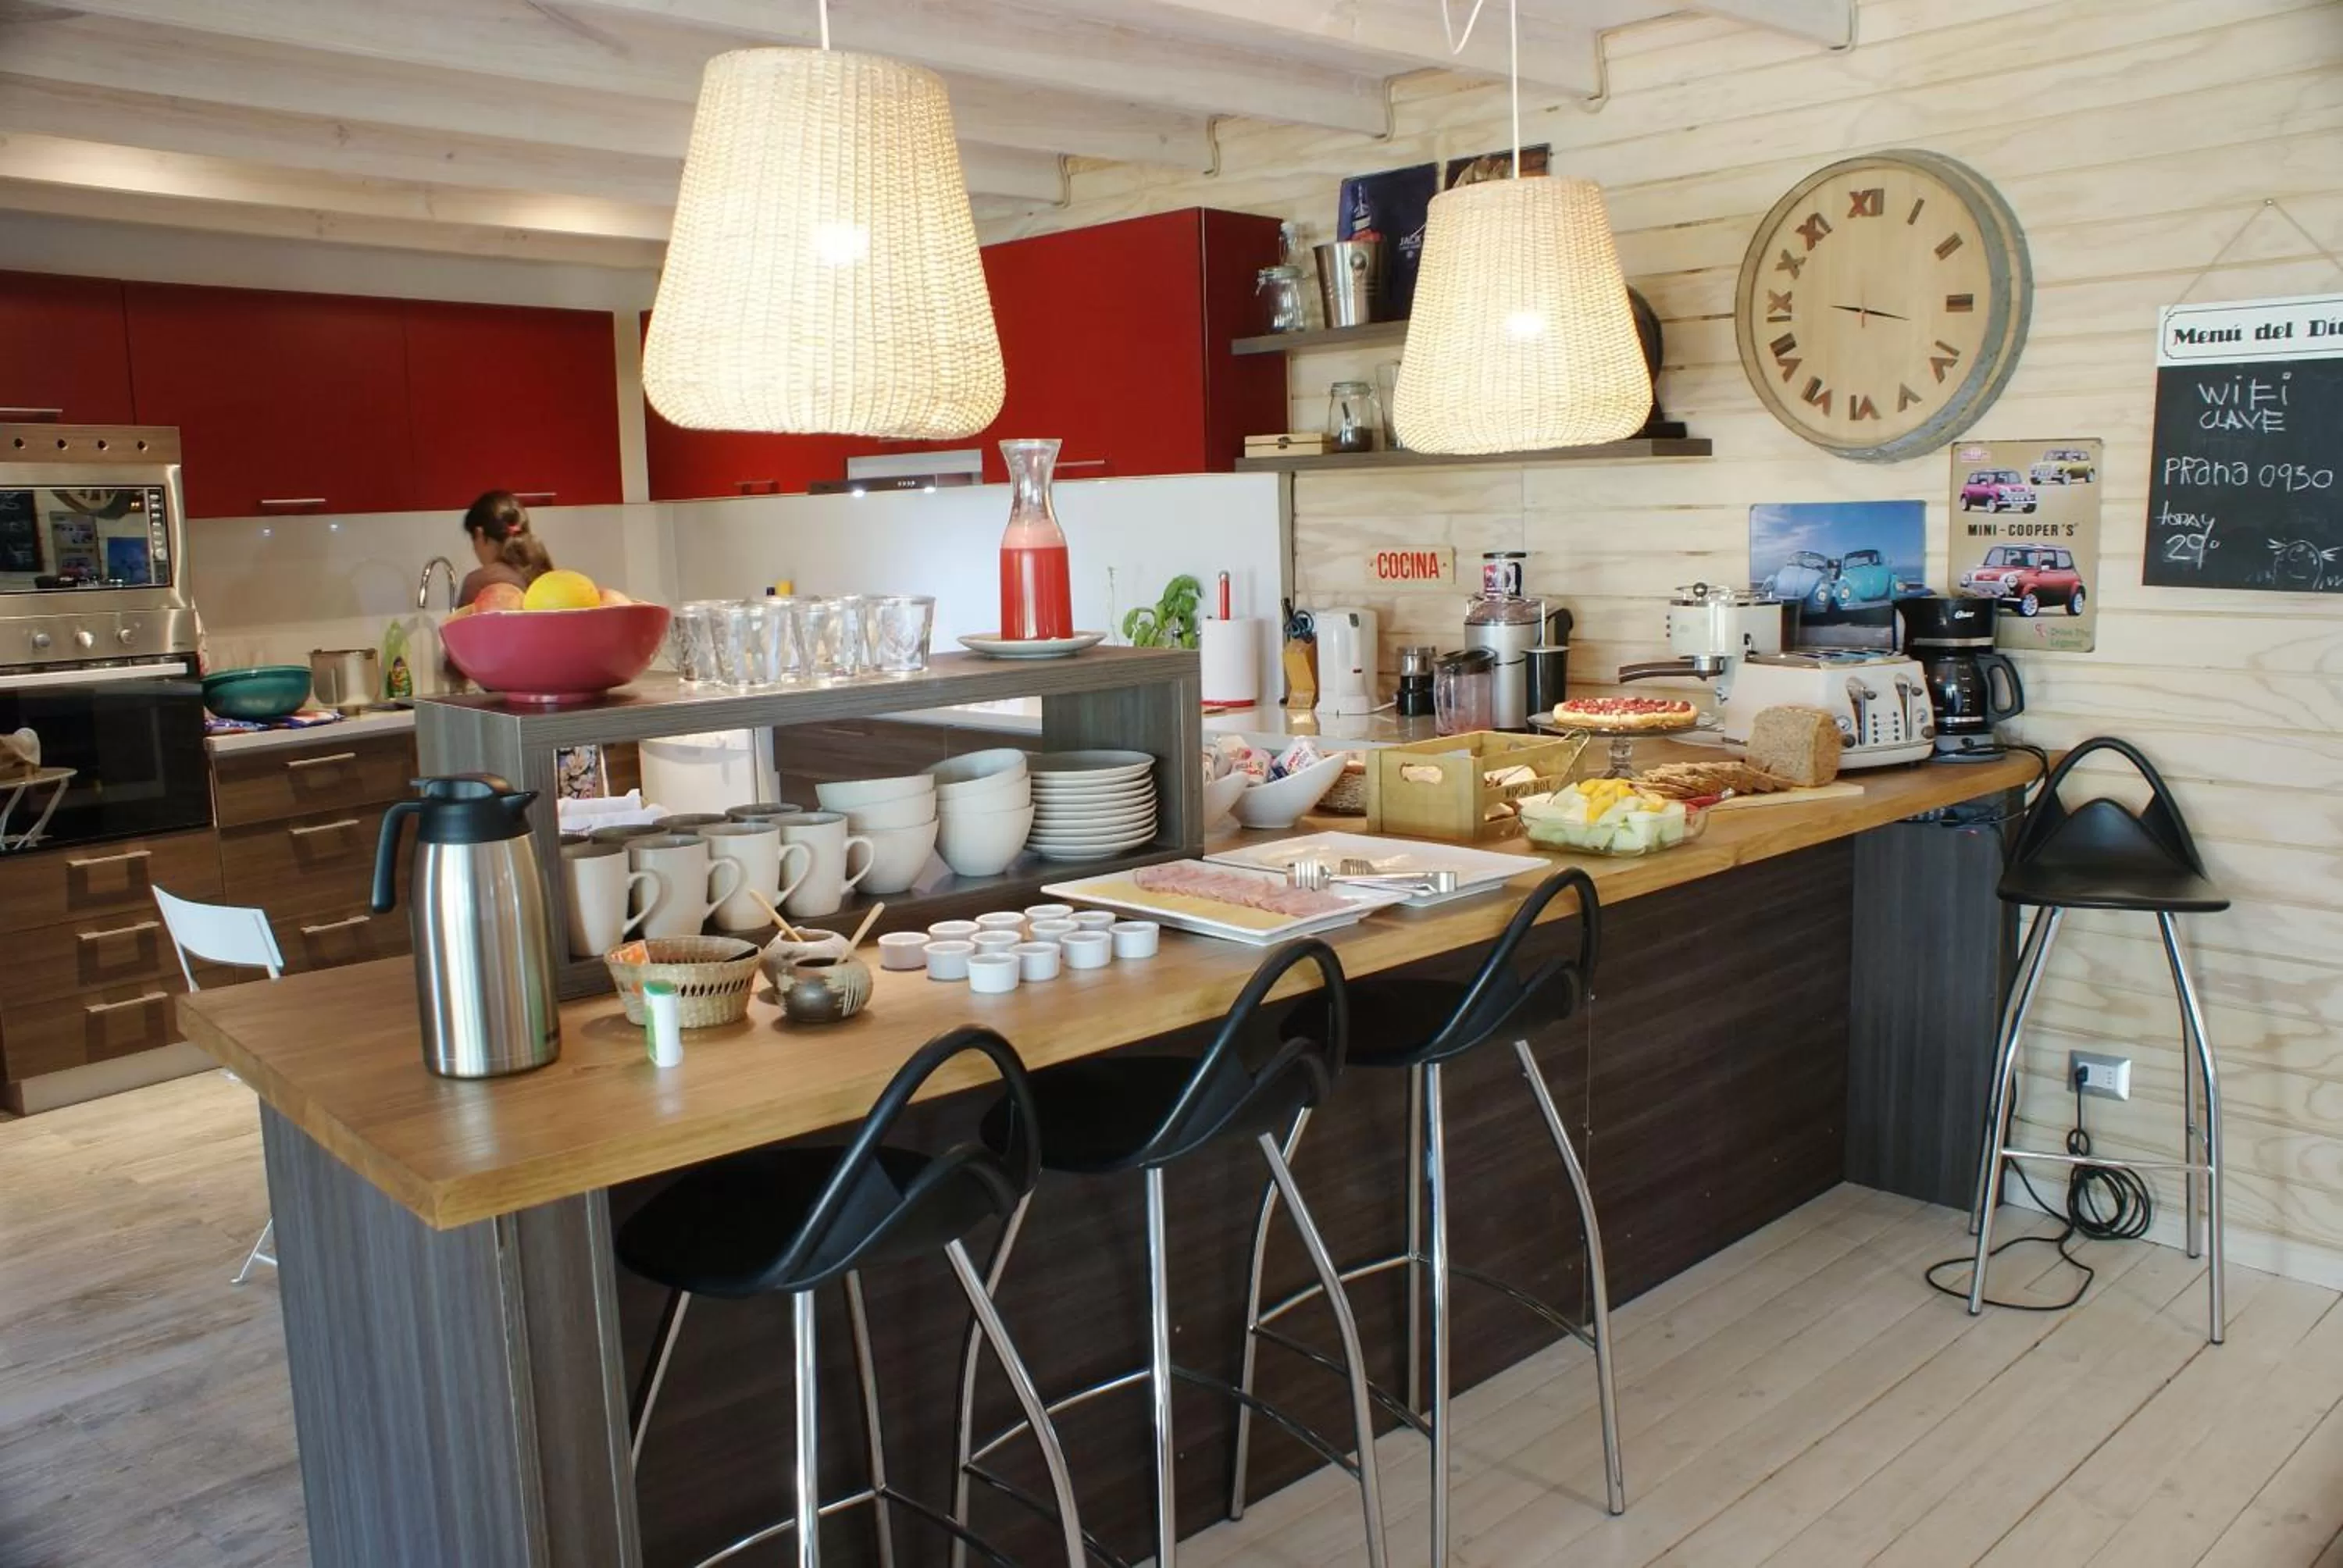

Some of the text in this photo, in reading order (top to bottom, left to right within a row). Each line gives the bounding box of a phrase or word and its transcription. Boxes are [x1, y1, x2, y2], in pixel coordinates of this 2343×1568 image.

[1774, 249, 1806, 279] X
[2174, 324, 2243, 345] Menú
[2255, 321, 2293, 340] del
[2199, 408, 2287, 434] CLAVE
[1377, 551, 1440, 579] COCINA
